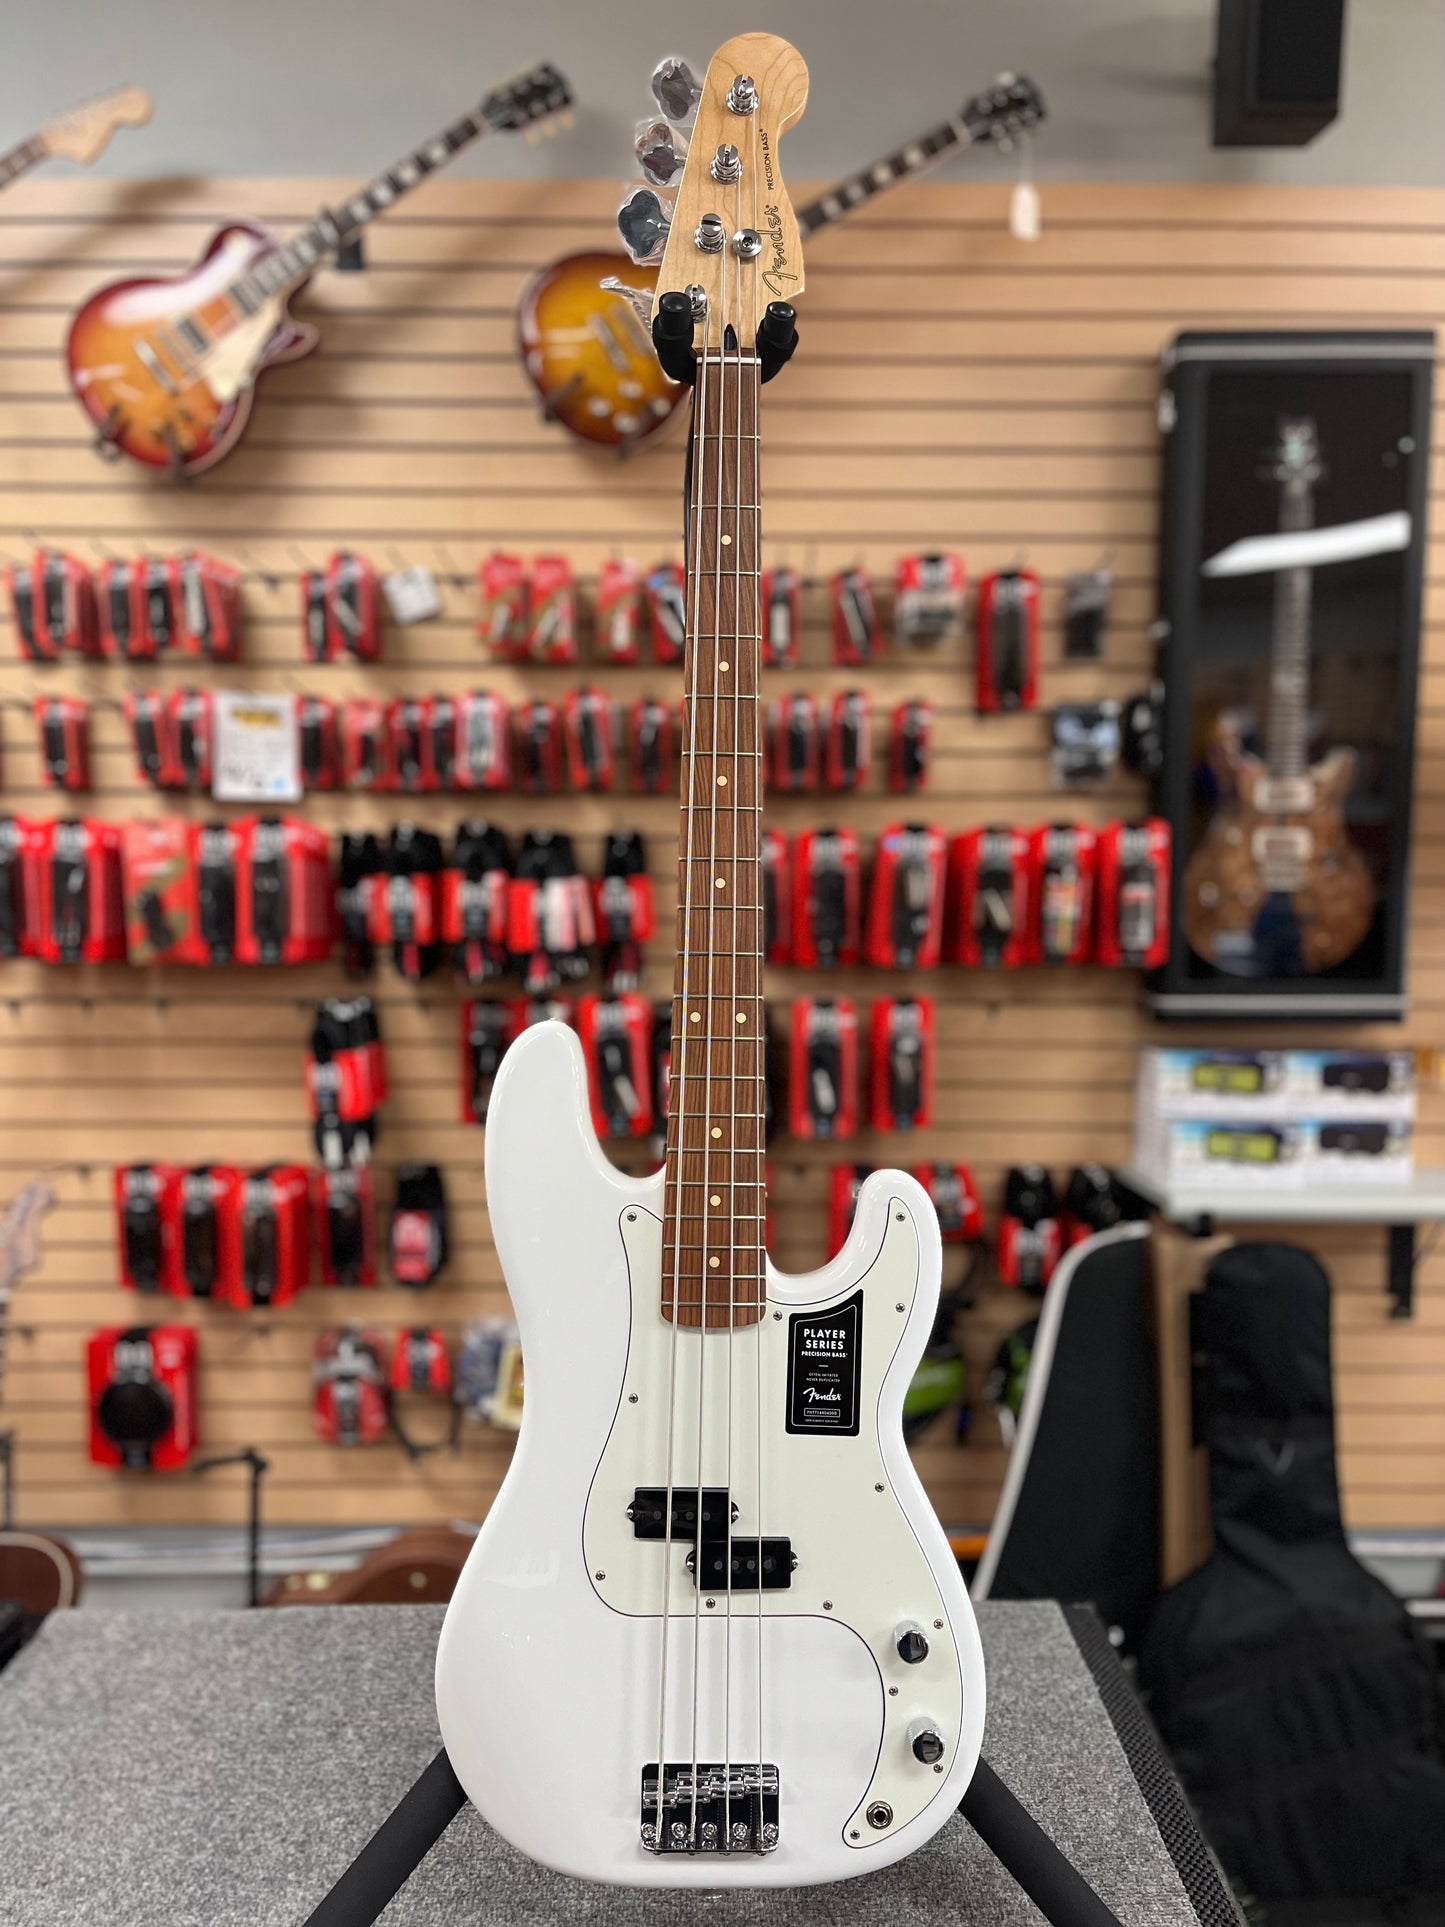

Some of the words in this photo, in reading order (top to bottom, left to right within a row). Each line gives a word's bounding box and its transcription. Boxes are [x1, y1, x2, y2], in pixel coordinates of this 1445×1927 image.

[764, 153, 774, 191] PRECISION
[757, 205, 798, 297] Fender
[804, 1328, 846, 1339] PLAYER
[805, 1340, 844, 1350] SERIES
[803, 1387, 842, 1403] Fender
